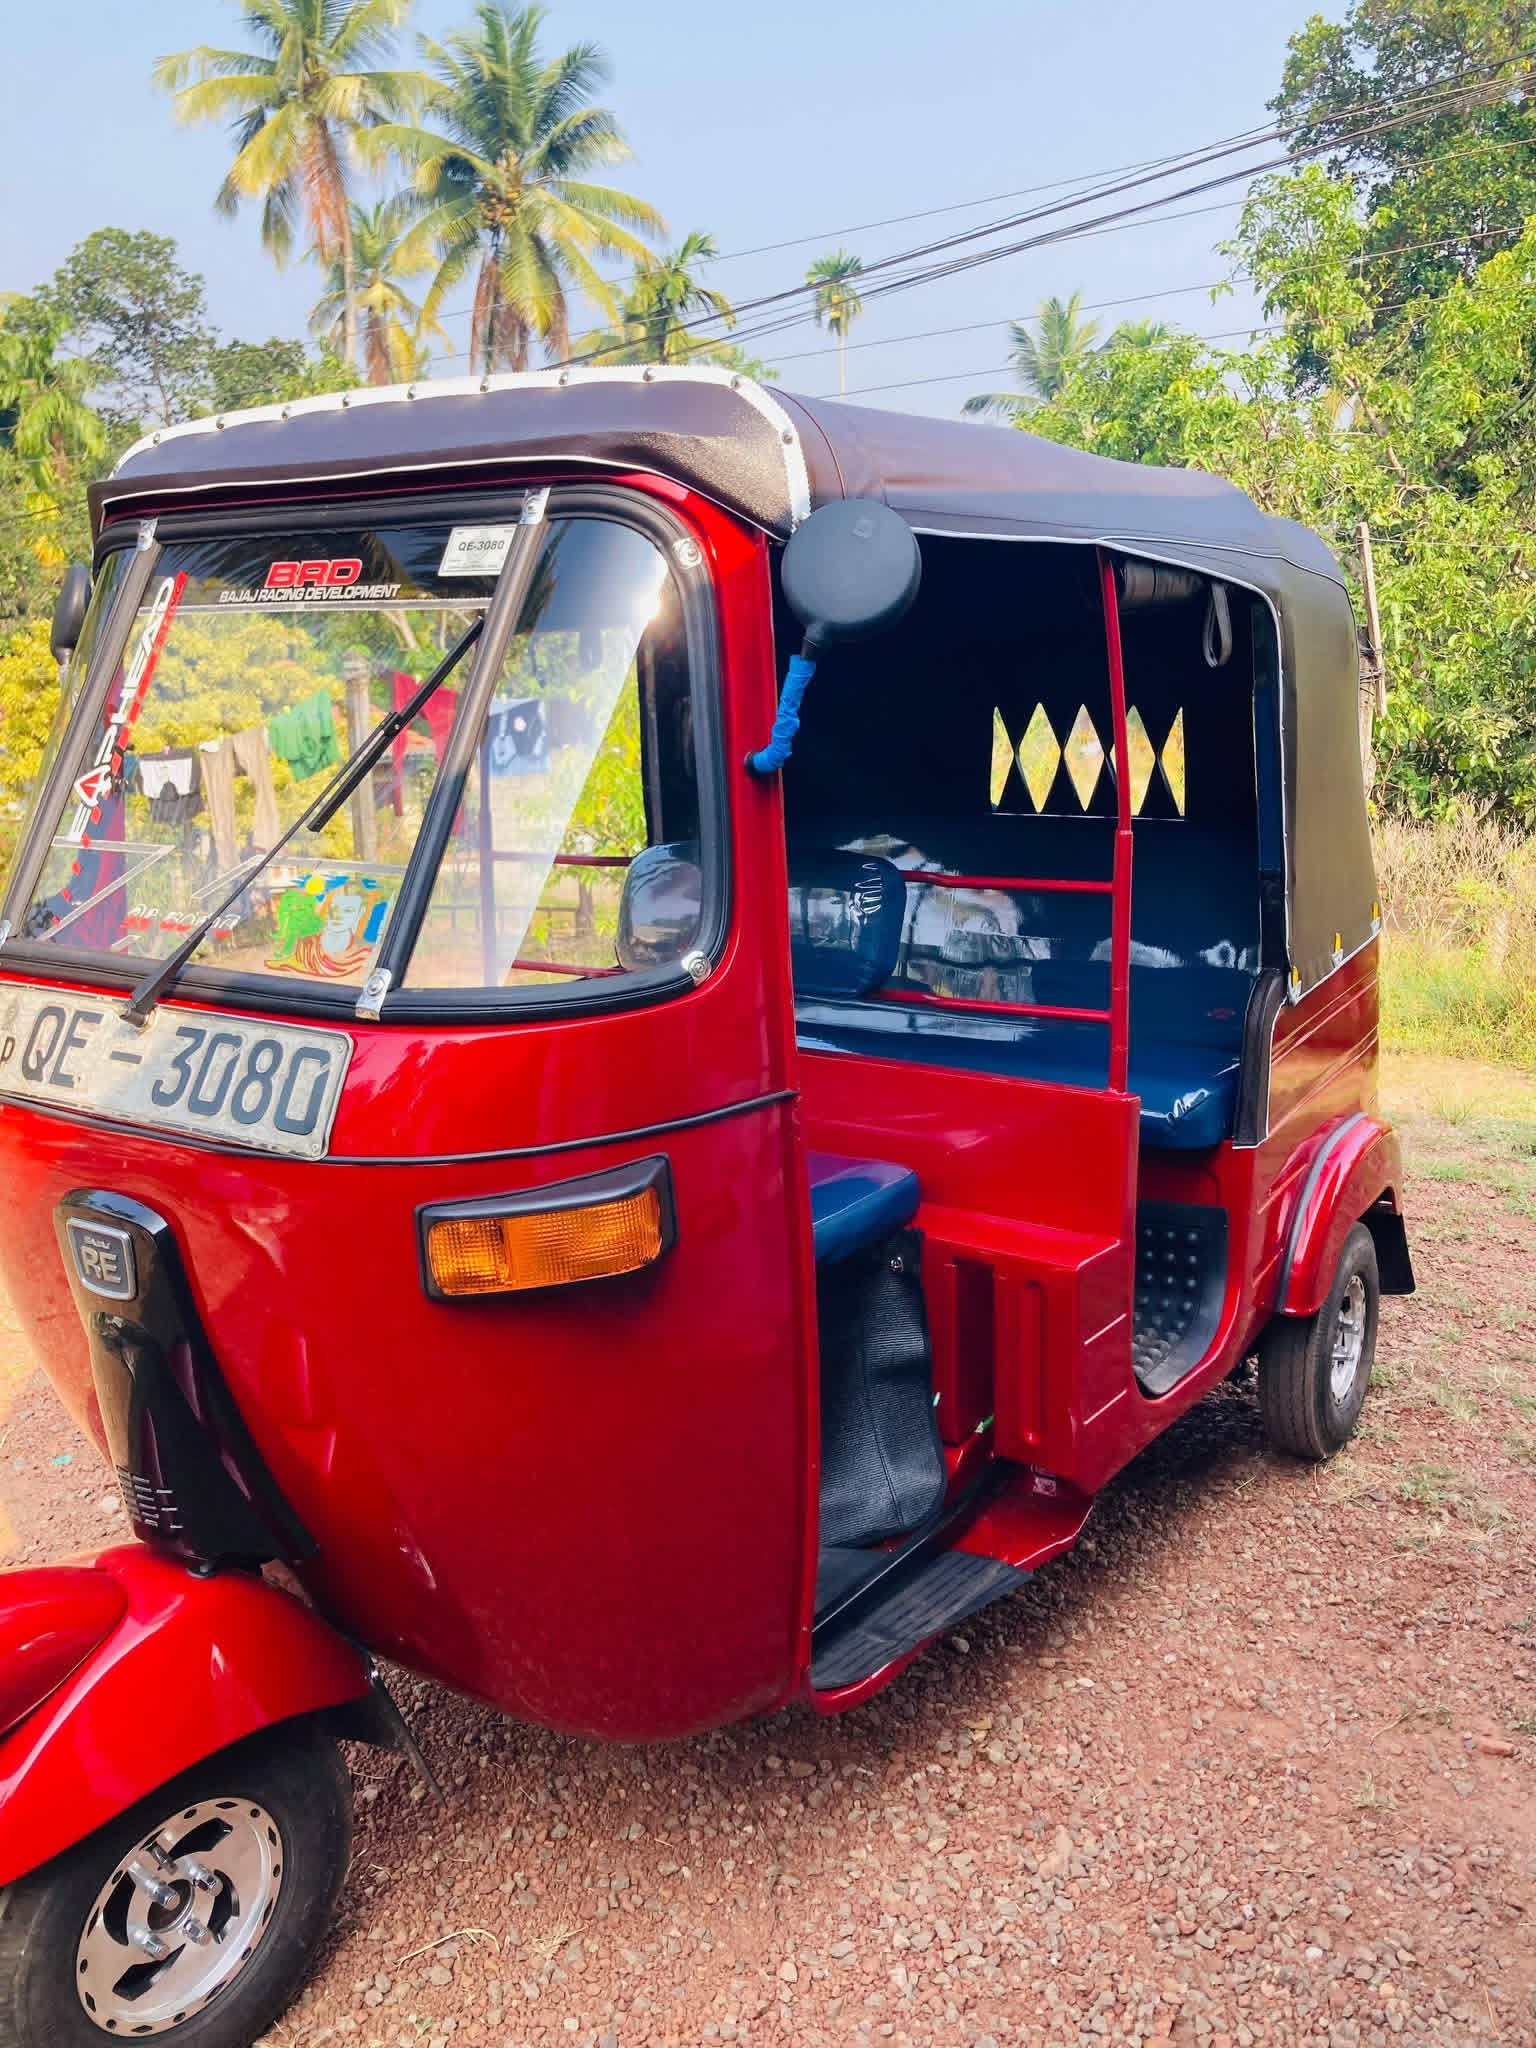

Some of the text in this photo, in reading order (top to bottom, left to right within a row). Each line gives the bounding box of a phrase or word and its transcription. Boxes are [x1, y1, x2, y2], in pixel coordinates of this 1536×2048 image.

[458, 540, 505, 552] QE-3080
[264, 558, 363, 589] BRD
[219, 584, 401, 603] BAJAJ RACING DEVELOPMENT
[80, 1245, 122, 1285] RE
